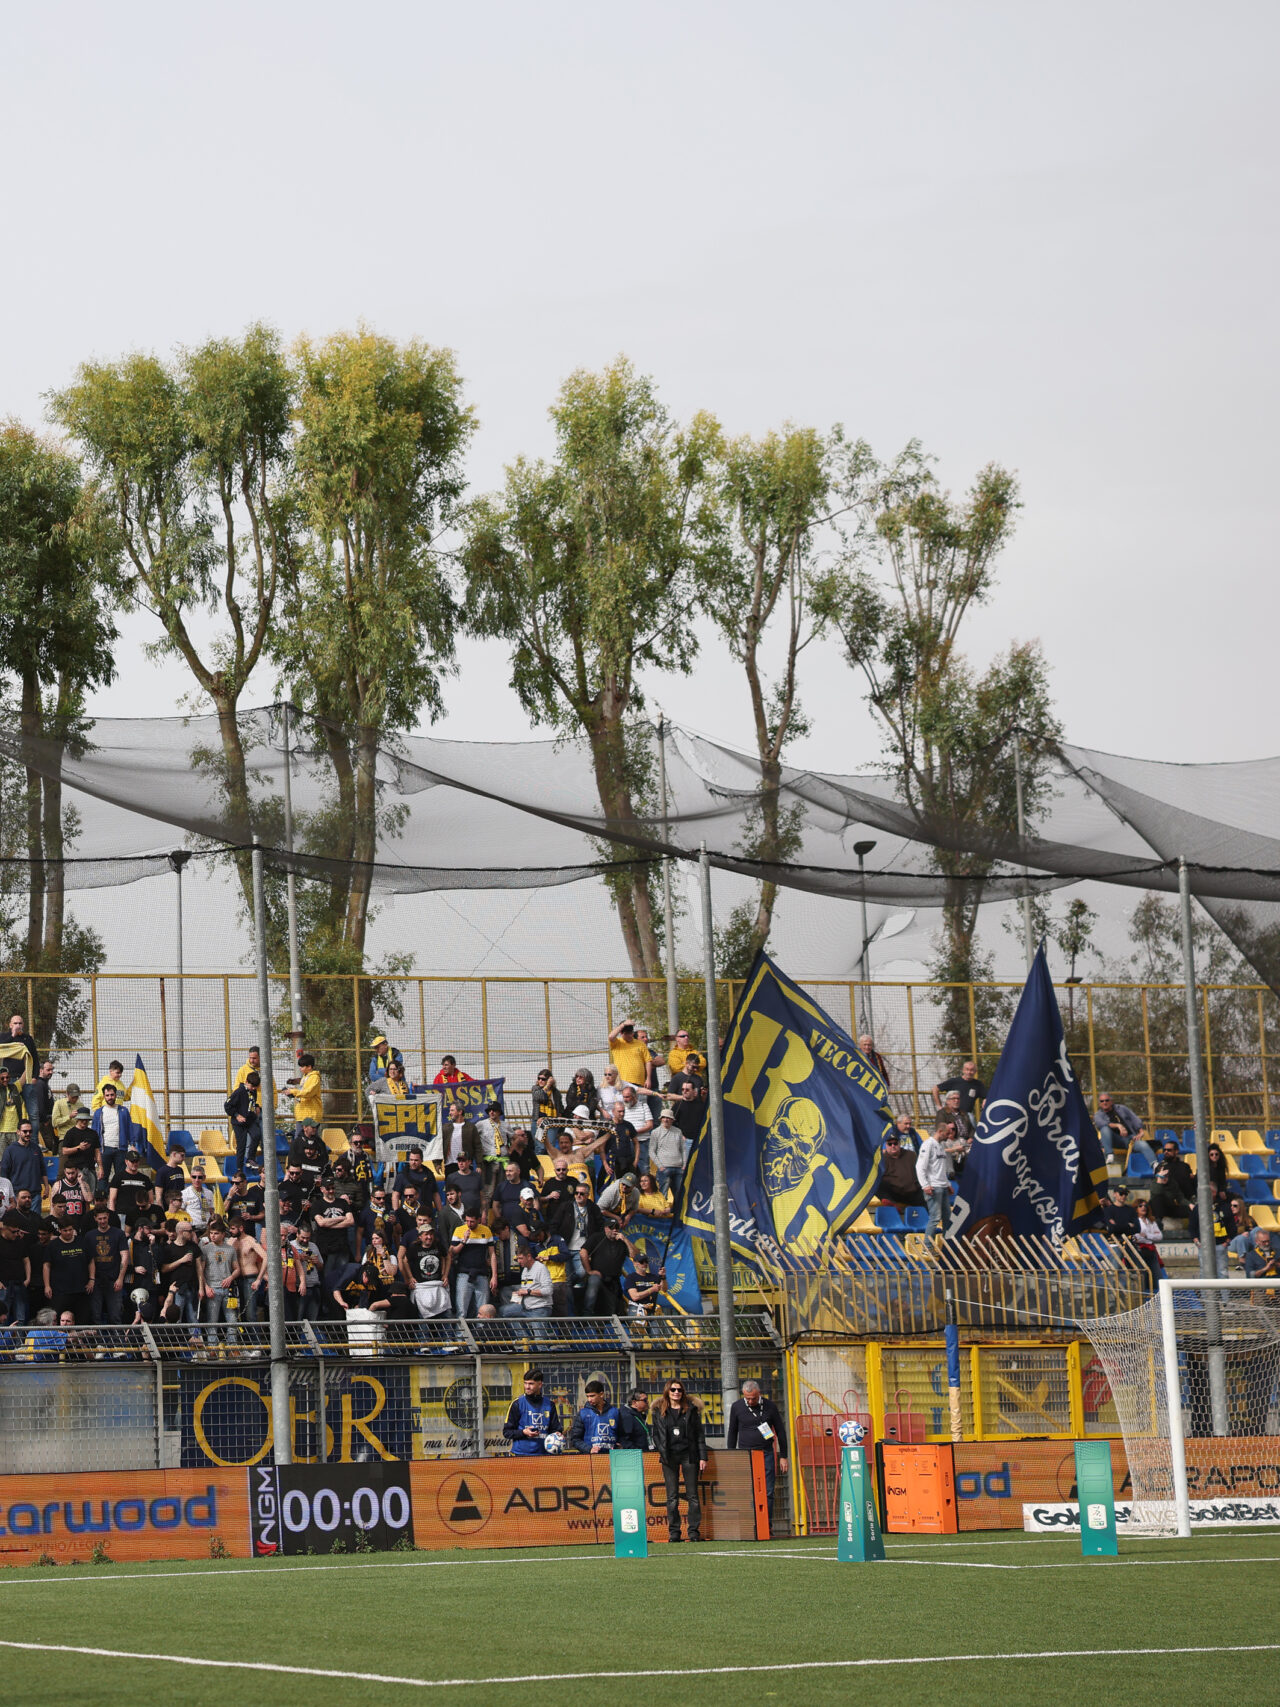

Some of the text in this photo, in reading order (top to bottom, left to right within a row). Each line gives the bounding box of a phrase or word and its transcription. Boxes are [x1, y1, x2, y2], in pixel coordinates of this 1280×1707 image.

[425, 1083, 498, 1109] ASSA
[376, 1103, 437, 1137] SPH
[66, 1202, 83, 1215] 33
[257, 1467, 277, 1546] NGM
[282, 1485, 410, 1533] 00:00
[1033, 1507, 1132, 1527] Golet
